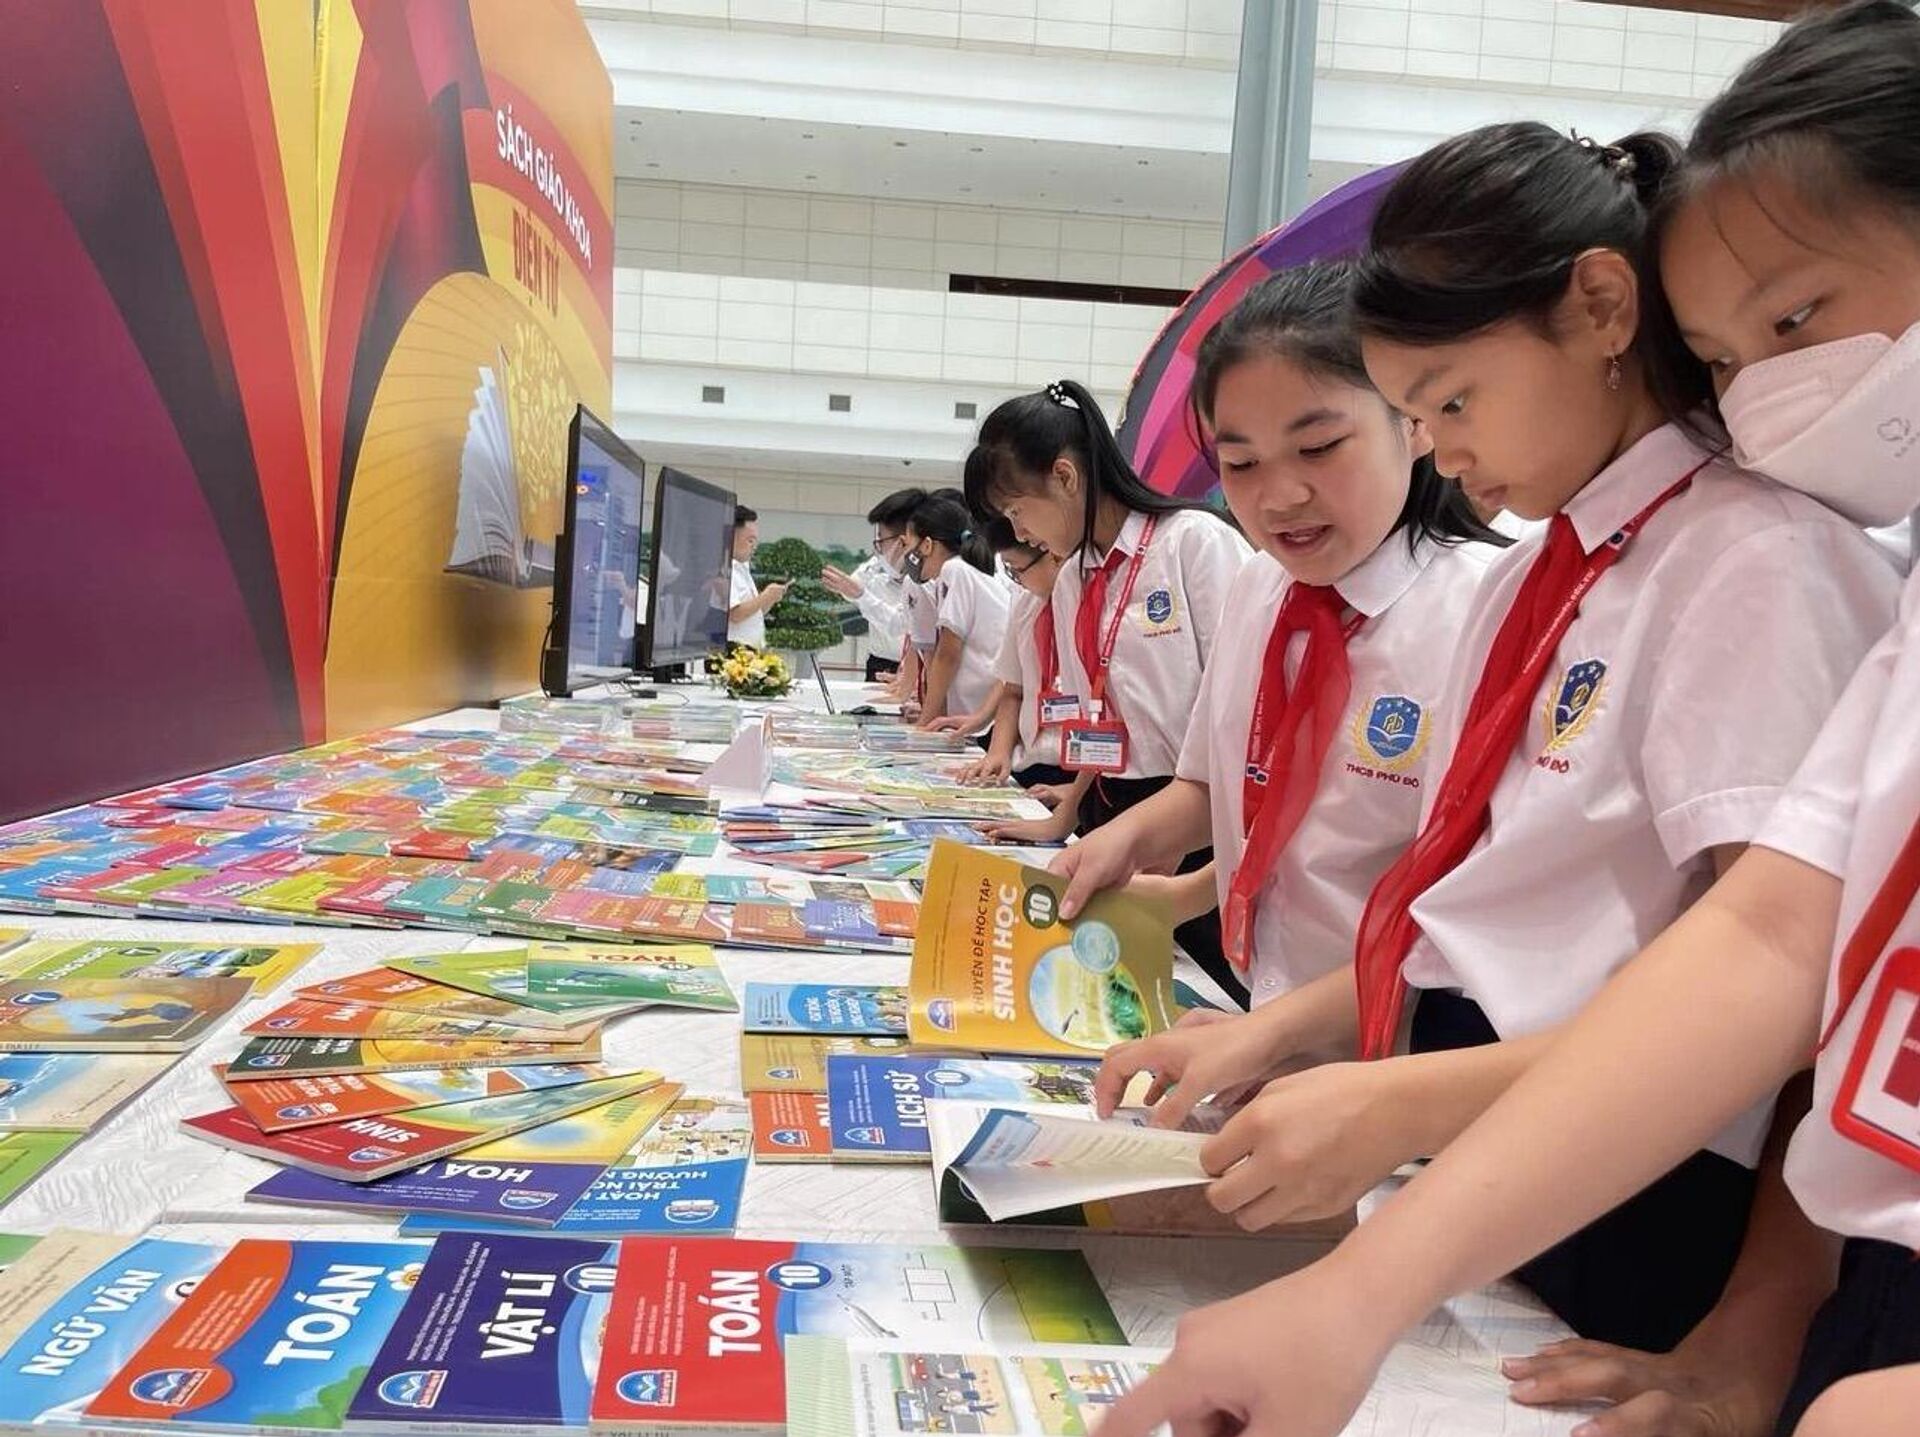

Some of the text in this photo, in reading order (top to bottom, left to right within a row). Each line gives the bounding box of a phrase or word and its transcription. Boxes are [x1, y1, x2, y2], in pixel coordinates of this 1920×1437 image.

[496, 104, 592, 269] SÁCH GIÁO KHOA
[512, 206, 543, 307] ĐIỆN
[1346, 763, 1420, 789] THCS PHÚ ĐÔ
[1027, 893, 1052, 922] 10
[992, 884, 1020, 1022] SINH HỌC
[884, 1069, 921, 1092] SỬ
[934, 1071, 964, 1084] 10
[341, 1118, 421, 1144] SINH
[579, 1267, 617, 1290] 10
[785, 1264, 821, 1289] 10
[19, 1315, 108, 1376] NGỮ
[84, 1269, 163, 1317] VĂN
[264, 1263, 387, 1367] TOÁN
[479, 1270, 557, 1360] VẬT LÍ
[697, 1269, 762, 1358] TOÁN
